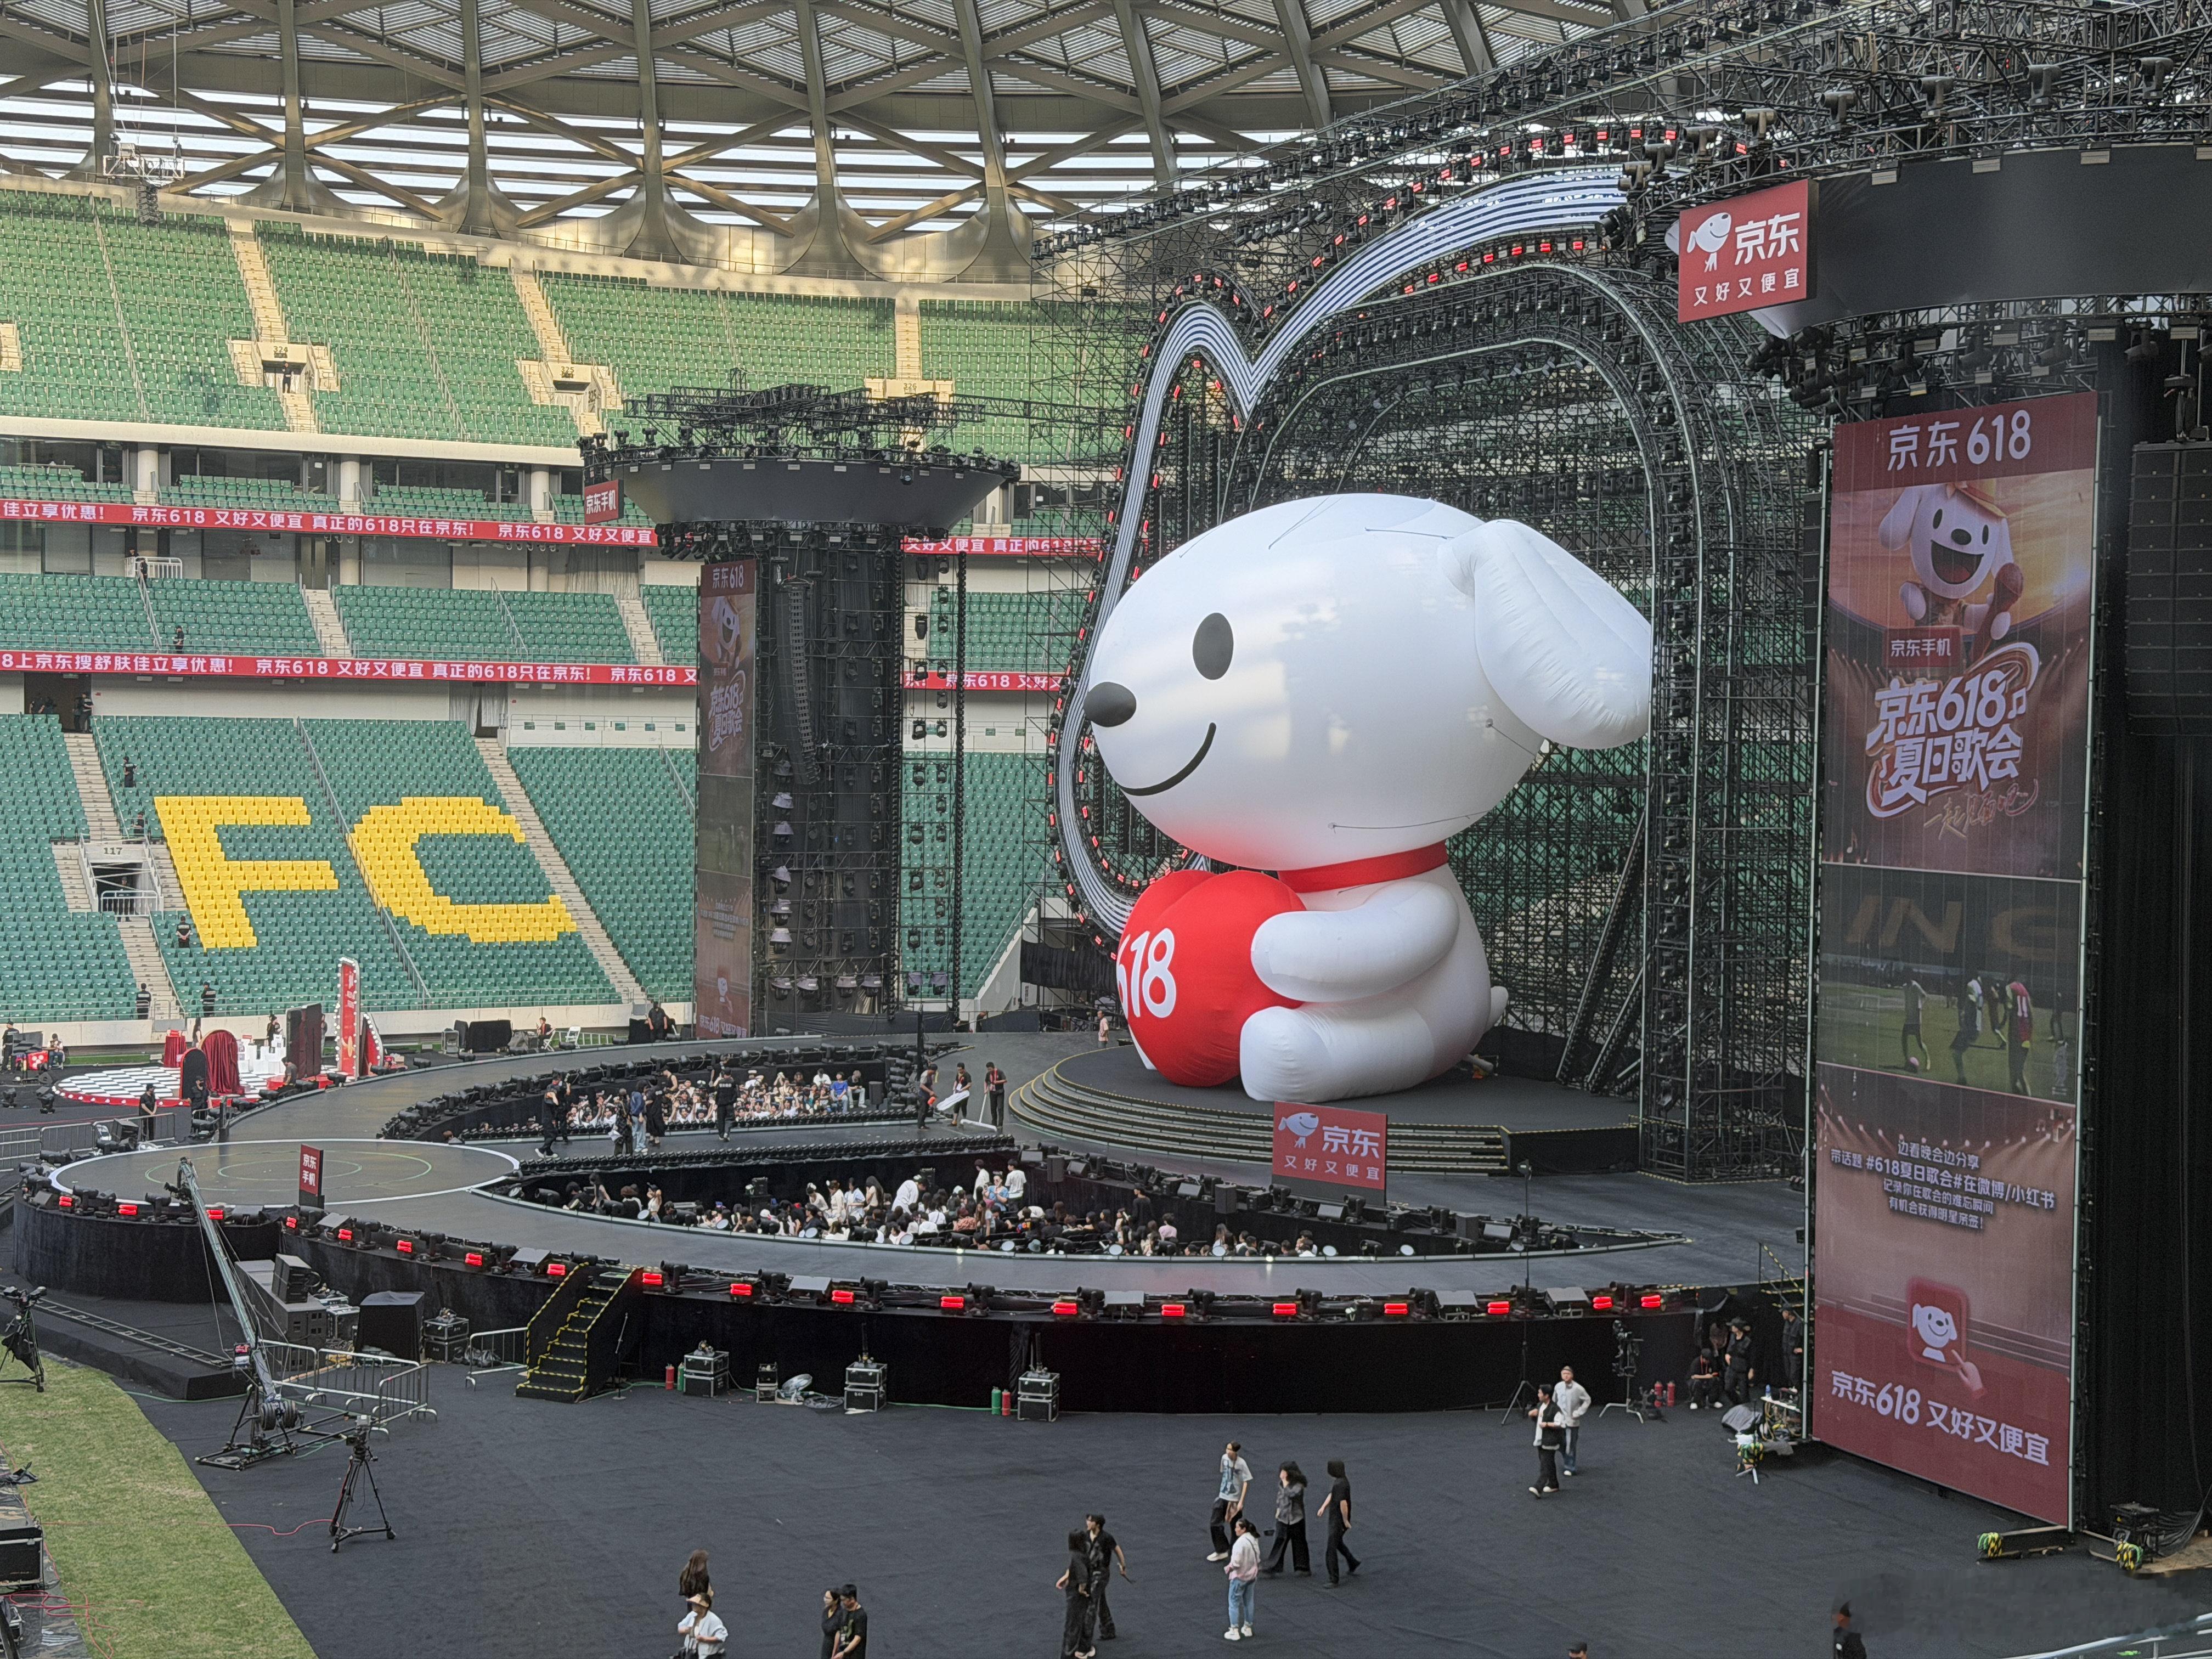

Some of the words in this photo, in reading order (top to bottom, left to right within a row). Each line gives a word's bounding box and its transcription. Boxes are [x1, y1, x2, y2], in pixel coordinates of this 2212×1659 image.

[1734, 212, 1801, 266] 京东
[1693, 268, 1799, 307] 又好又便宜
[1887, 410, 2030, 471] 京东618
[586, 489, 616, 515] 京东手机
[3, 501, 104, 520] 佳立享优惠!
[132, 507, 205, 524] 京东618
[215, 511, 303, 529] 又好又便宜
[312, 515, 473, 537] 真正的618只在京东!
[498, 524, 563, 540] 京东618
[571, 527, 652, 544] 又好又便宜
[713, 565, 744, 589] 京东618
[1891, 637, 1951, 657] 京东手机
[256, 659, 328, 675] 京东618
[336, 661, 424, 678] 又好又便宜
[432, 663, 590, 681] 真正的618只在京东!
[611, 667, 676, 682] 京东618
[1865, 669, 2007, 751] 京东618
[1881, 723, 2023, 808] 夏日歌会
[1322, 1125, 1380, 1159] 京东
[1898, 1141, 1979, 1170] 边看晚会边分享
[303, 1154, 317, 1170] 京东
[1284, 1155, 1380, 1181] 又好又便宜
[302, 1170, 315, 1186] 手机
[1831, 1370, 1921, 1425] 京东618
[1926, 1400, 2049, 1466] 又好又便宜
